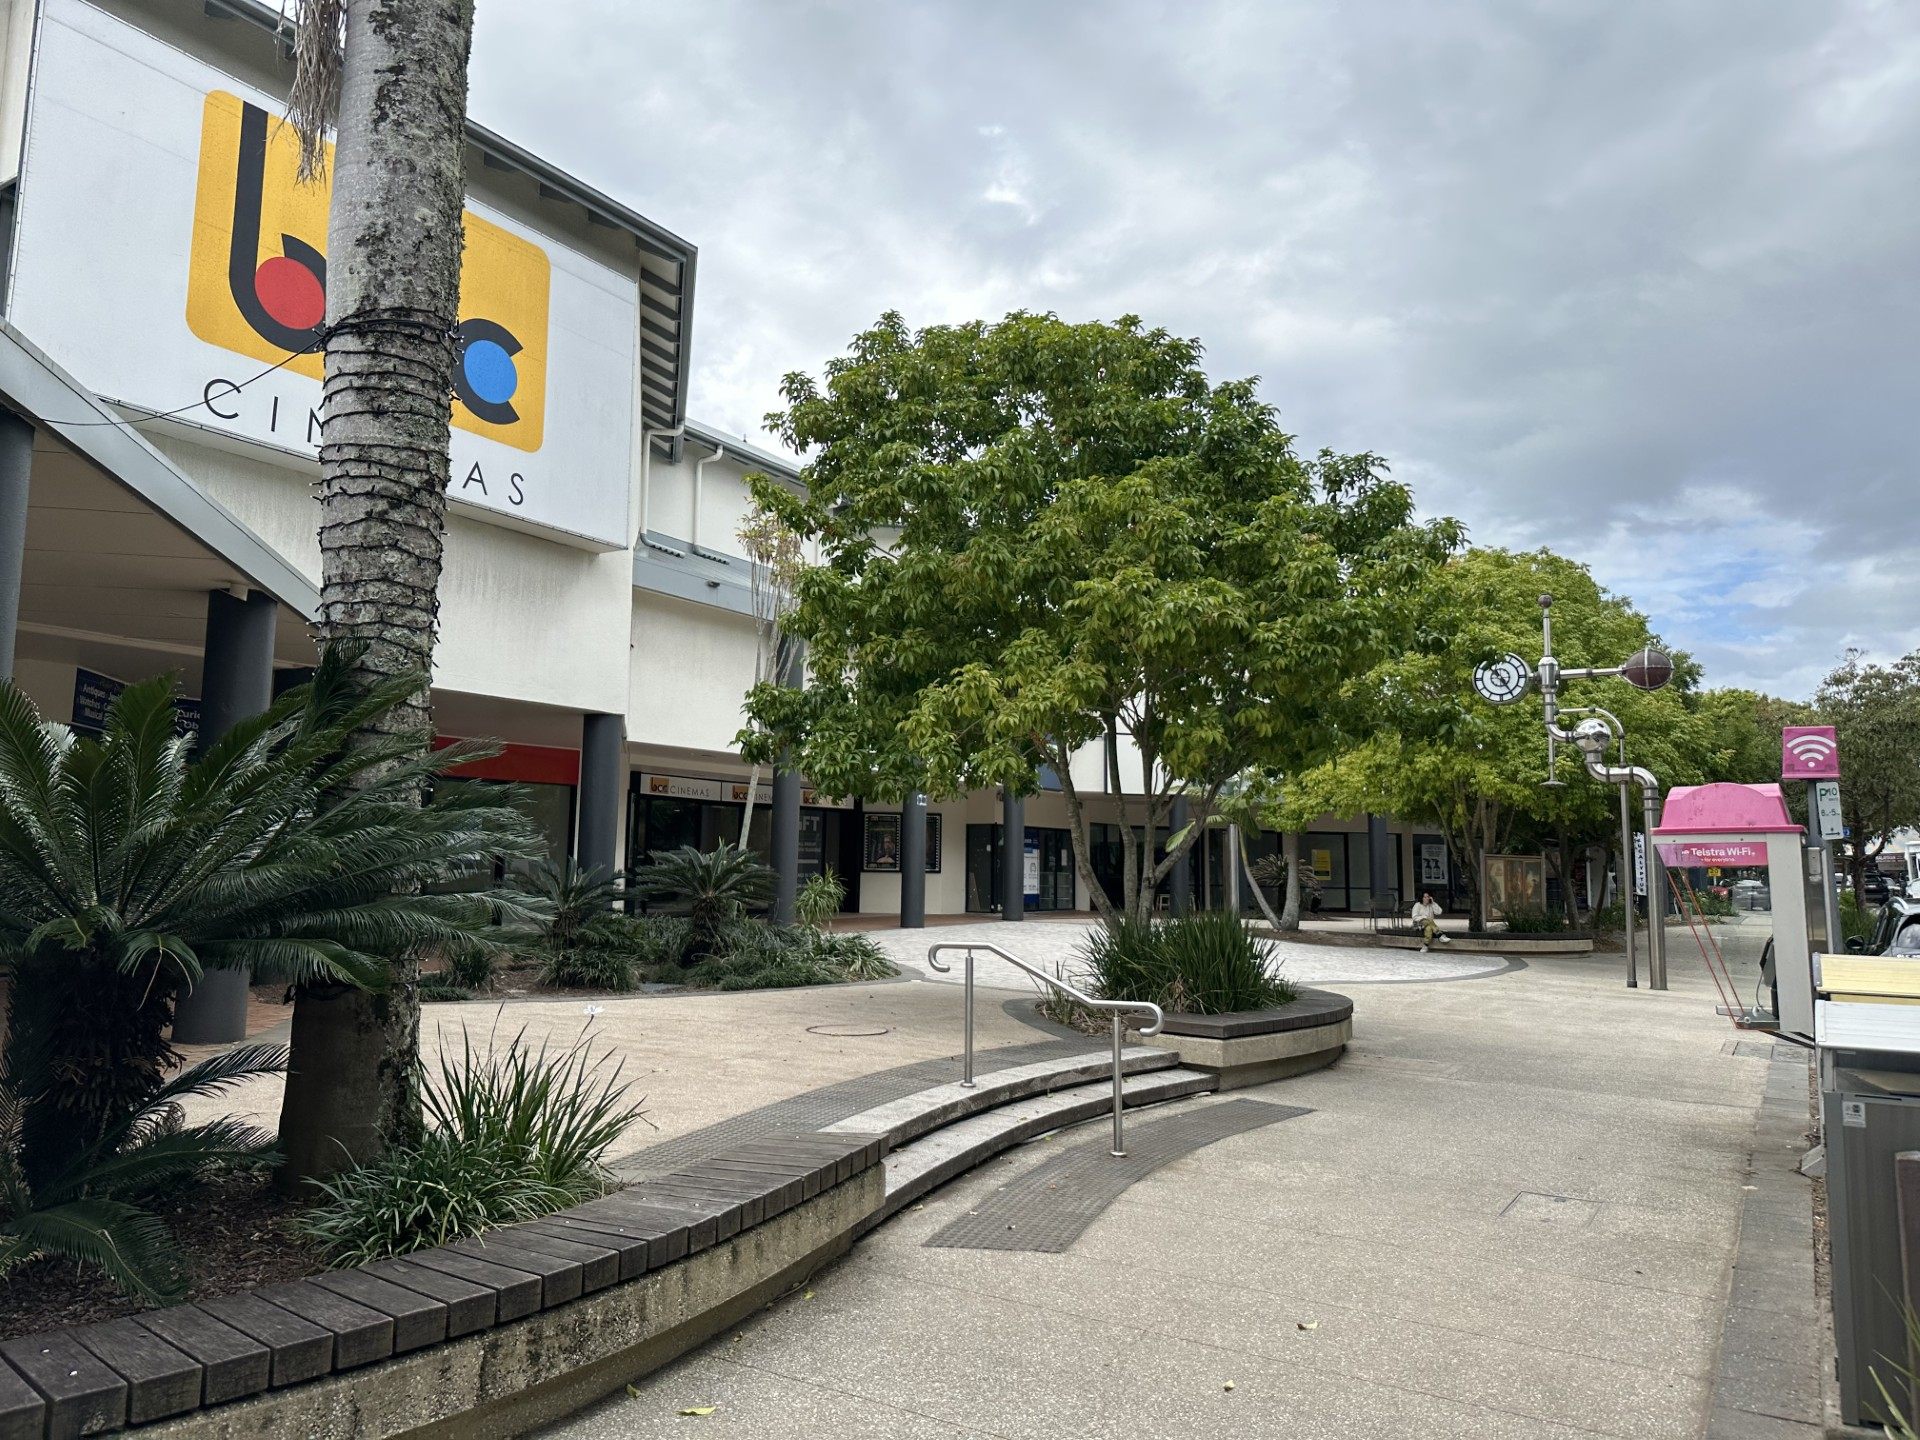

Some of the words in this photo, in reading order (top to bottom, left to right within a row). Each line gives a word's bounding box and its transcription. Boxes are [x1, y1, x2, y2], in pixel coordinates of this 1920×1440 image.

[204, 378, 525, 506] CINAS
[669, 785, 710, 798] CINEMAS
[1691, 847, 1725, 857] Telstra
